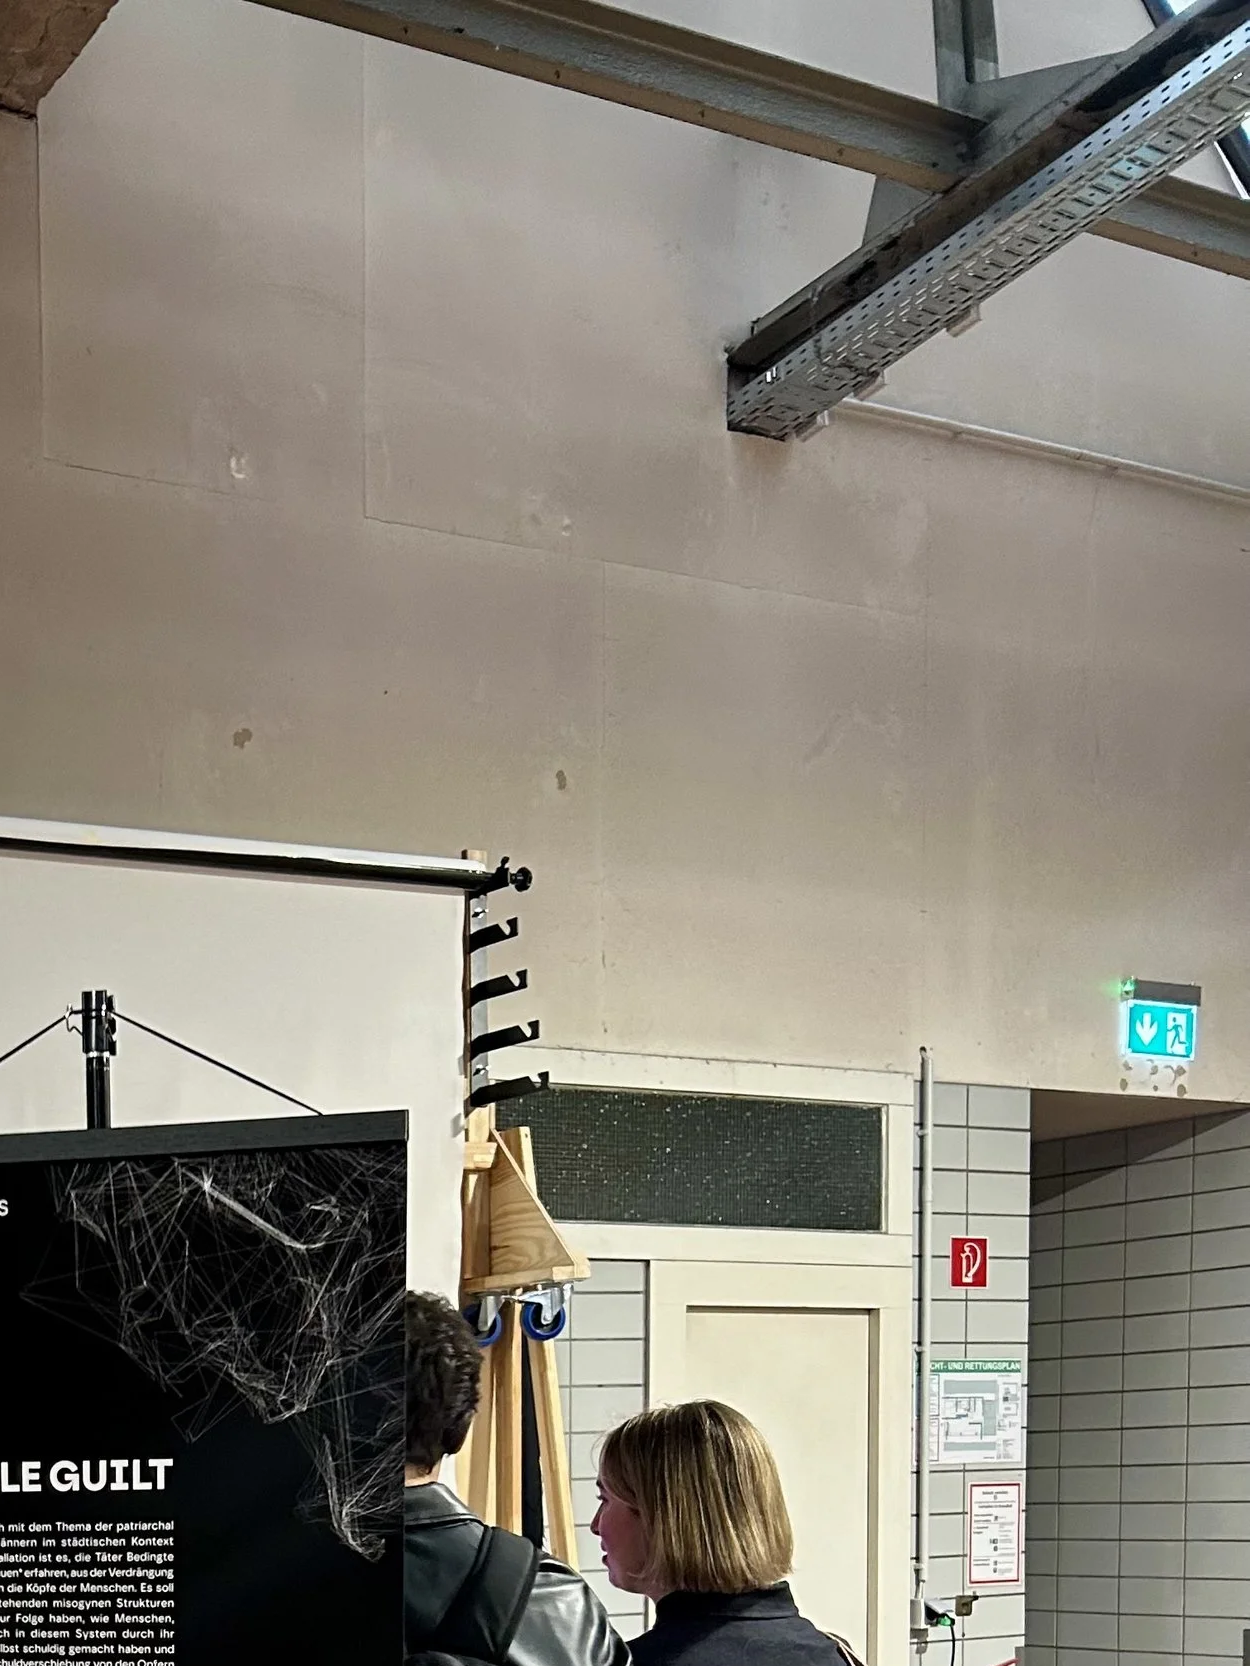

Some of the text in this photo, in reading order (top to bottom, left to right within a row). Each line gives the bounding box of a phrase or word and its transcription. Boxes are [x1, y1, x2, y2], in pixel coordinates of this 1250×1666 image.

[964, 1361, 1021, 1370] RETTUNGSPLAN
[49, 1458, 174, 1492] GUILT
[54, 1521, 92, 1531] Thema
[116, 1520, 174, 1533] patriarchal
[60, 1536, 126, 1547] städtischen
[130, 1536, 174, 1546] Kontext
[94, 1552, 123, 1562] Täter
[126, 1551, 174, 1564] Bedingte
[23, 1568, 69, 1578] erfahren,
[107, 1567, 174, 1579] Verdrängung
[25, 1583, 57, 1595] Köpfe
[79, 1582, 137, 1592] Menschen.
[52, 1598, 112, 1610] misogynen
[116, 1598, 175, 1608] Strukturen
[15, 1613, 45, 1625] Folge
[48, 1613, 86, 1624] haben,
[114, 1613, 175, 1624] Menschen,
[29, 1628, 70, 1638] diesem
[75, 1628, 117, 1640] System
[121, 1629, 154, 1639] durch
[22, 1643, 66, 1655] schuldig
[68, 1644, 115, 1656] gemacht
[117, 1644, 151, 1654] haben
